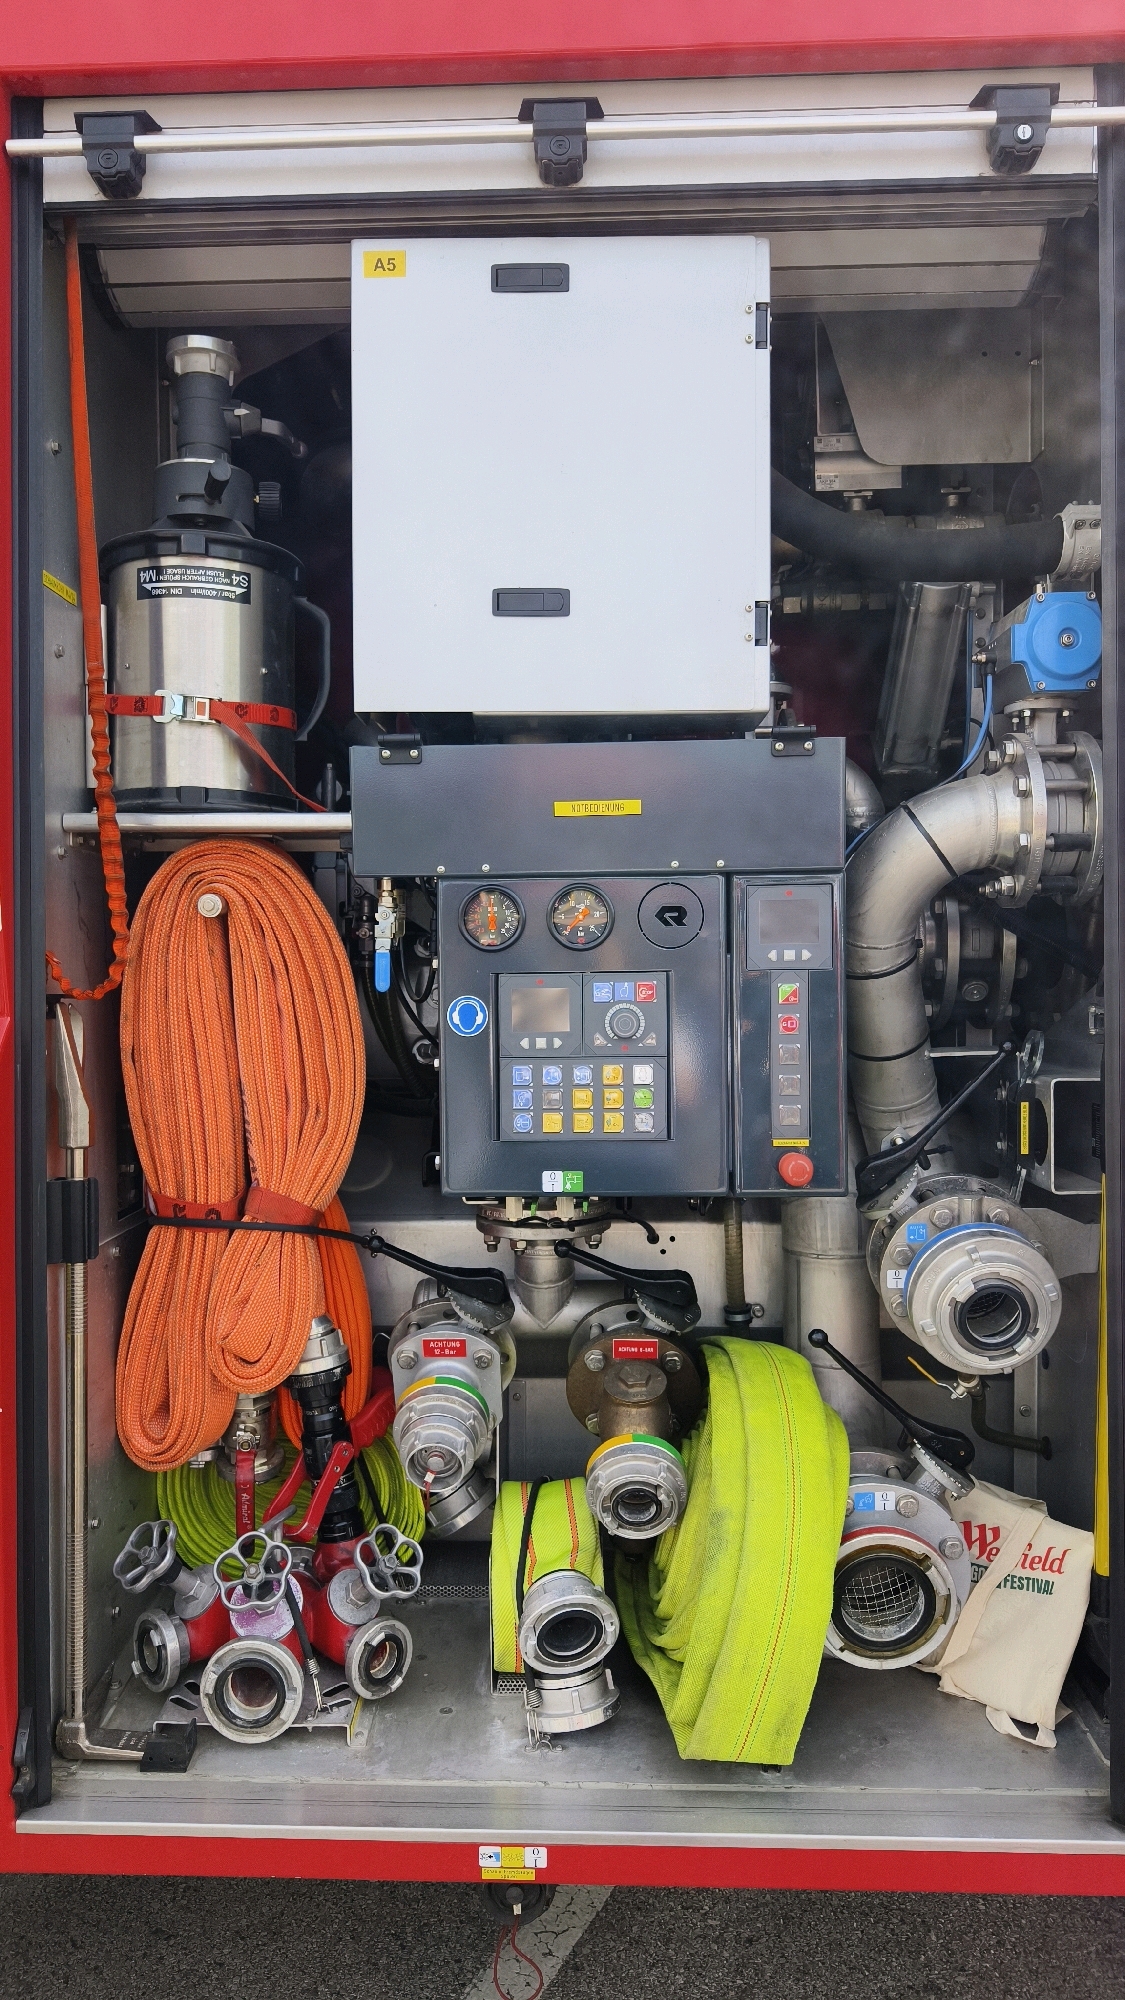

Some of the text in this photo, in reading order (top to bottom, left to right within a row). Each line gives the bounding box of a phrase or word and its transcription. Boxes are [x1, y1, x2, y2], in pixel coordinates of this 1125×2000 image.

[374, 258, 396, 271] A5
[140, 569, 156, 583] M4
[232, 573, 248, 587] S4
[571, 803, 624, 812] NOTBEDIENUNG
[241, 1492, 251, 1523] Admiral
[1003, 1574, 1055, 1596] FESTIVAL
